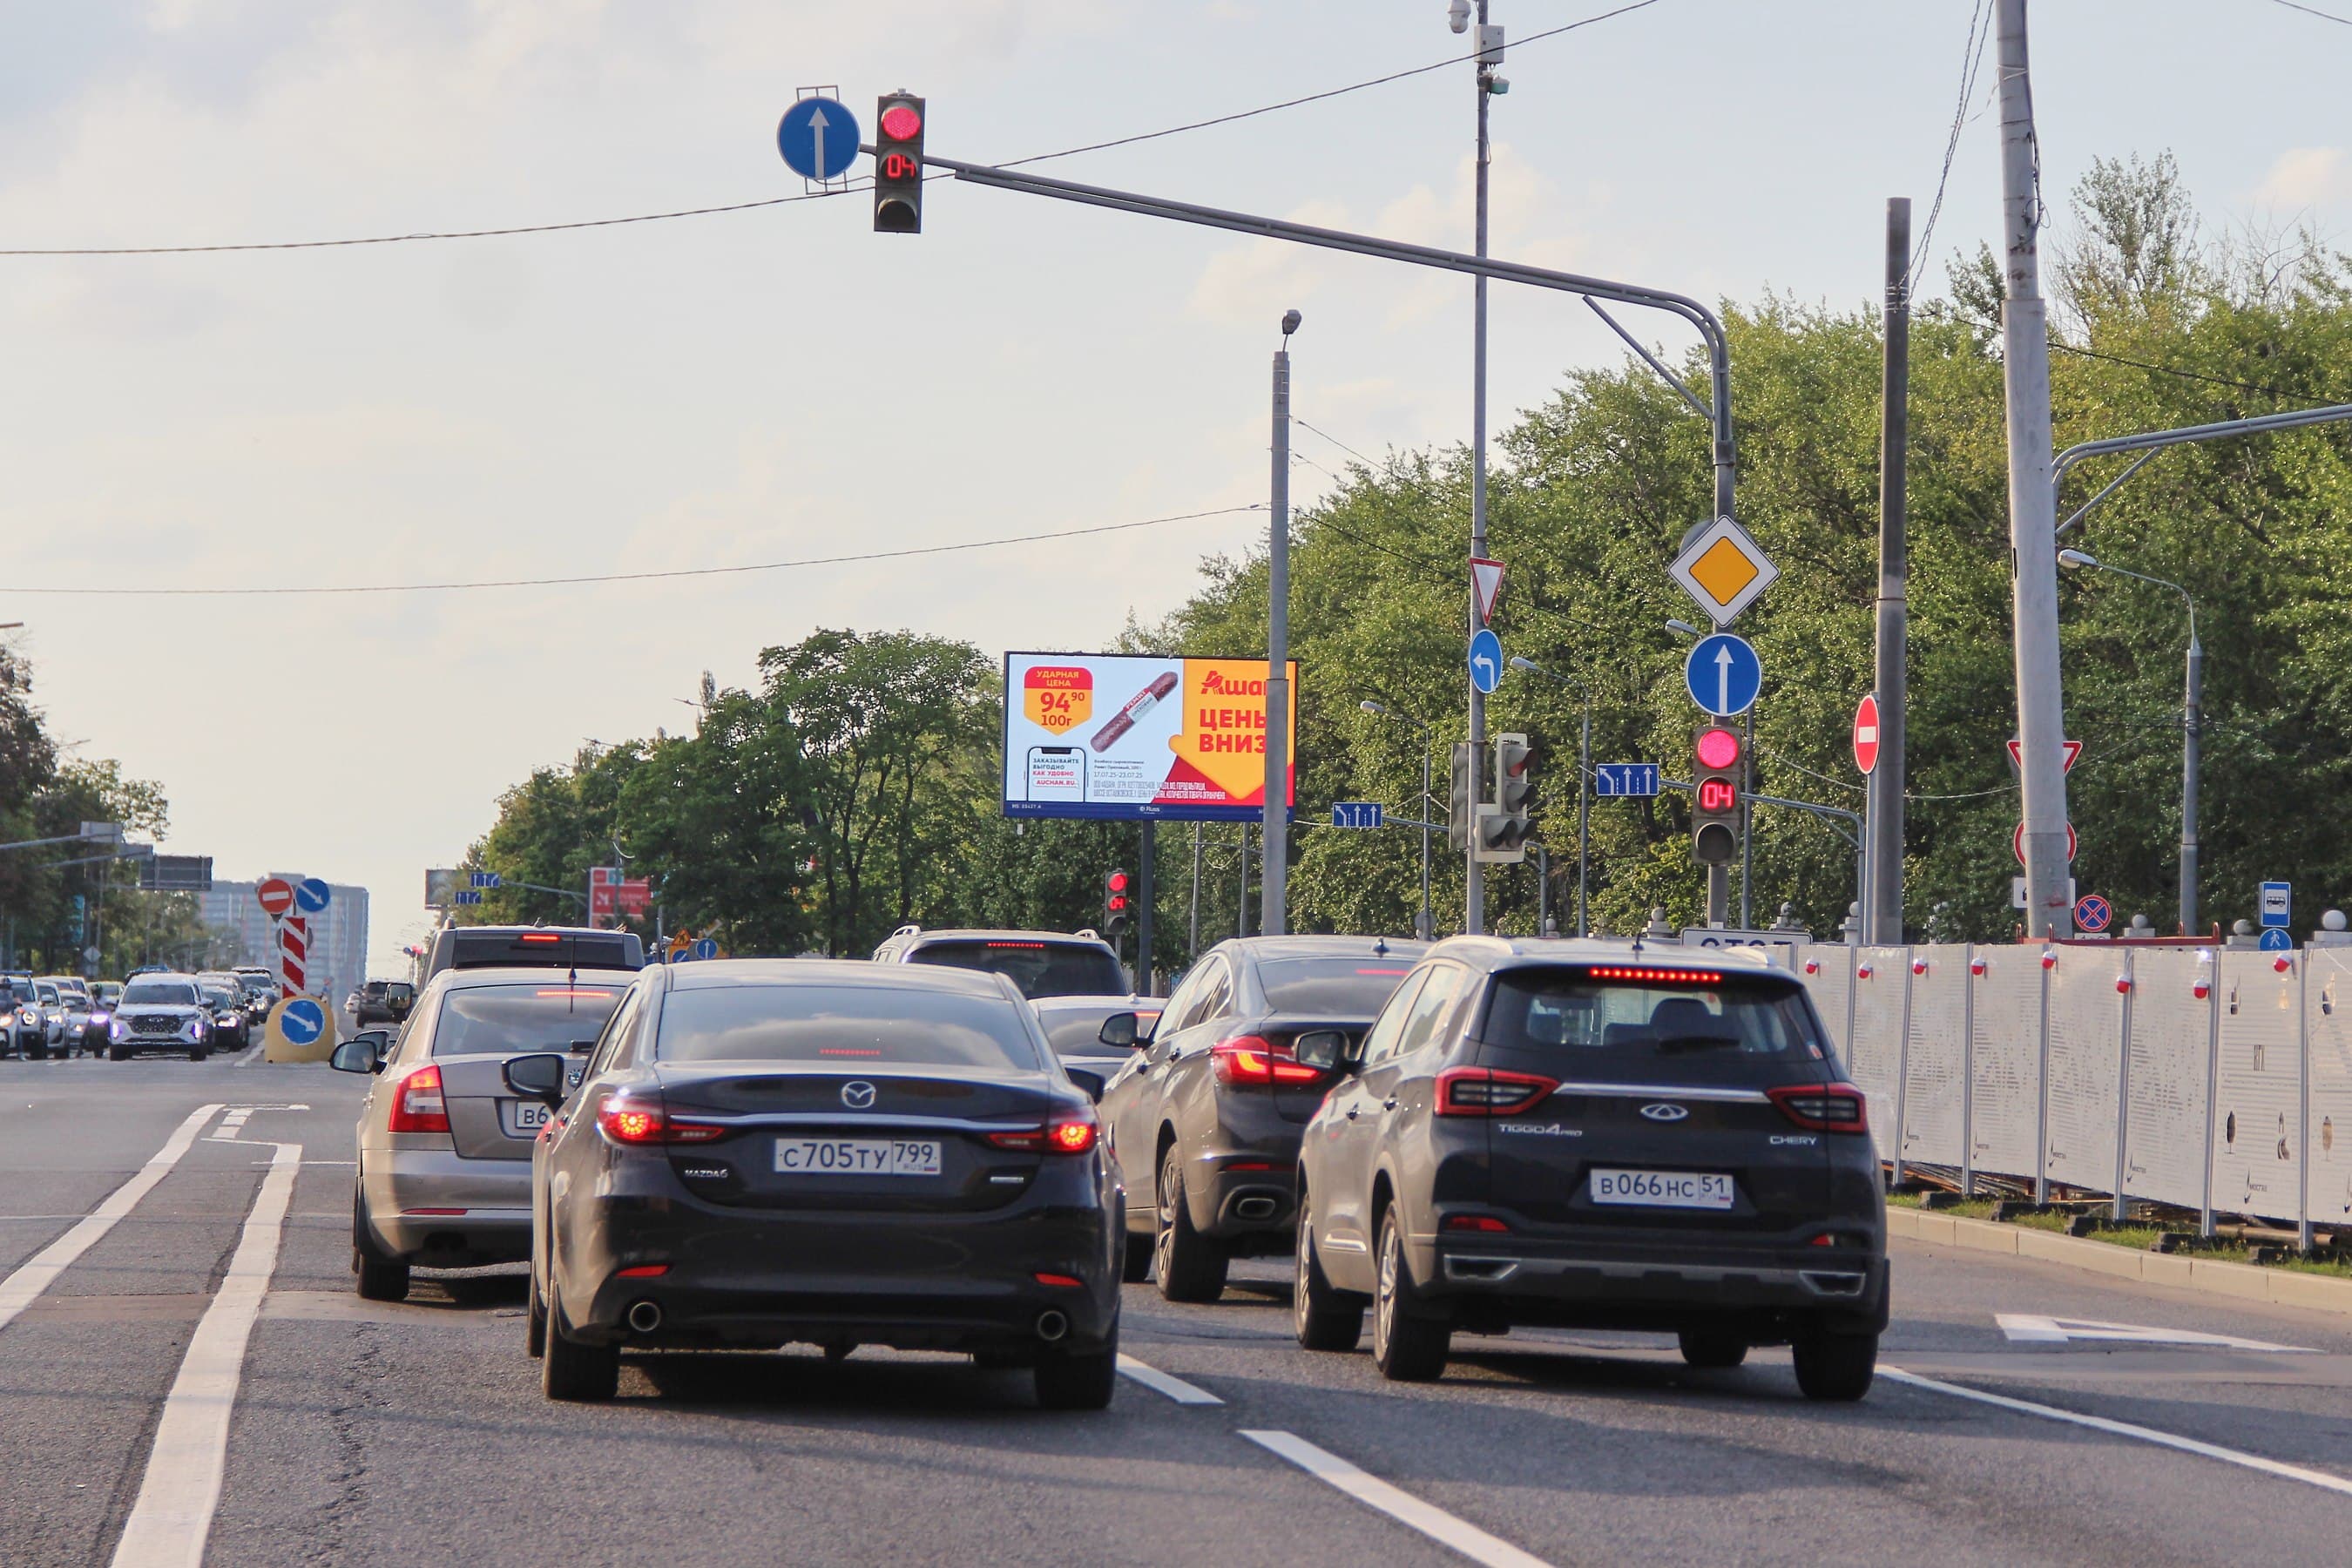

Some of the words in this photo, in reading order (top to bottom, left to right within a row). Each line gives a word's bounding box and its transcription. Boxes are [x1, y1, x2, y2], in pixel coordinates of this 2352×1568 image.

[888, 152, 916, 179] 04
[1036, 670, 1079, 679] УДАРНАЯ
[1200, 670, 1267, 696] Аша
[1040, 692, 1071, 713] 94
[1041, 714, 1072, 727] 100г
[1199, 733, 1267, 754] ВНИЗ
[1705, 784, 1732, 808] 04
[1769, 1136, 1817, 1146] CHERY
[895, 1143, 933, 1163] 799
[1702, 1176, 1725, 1193] 51
